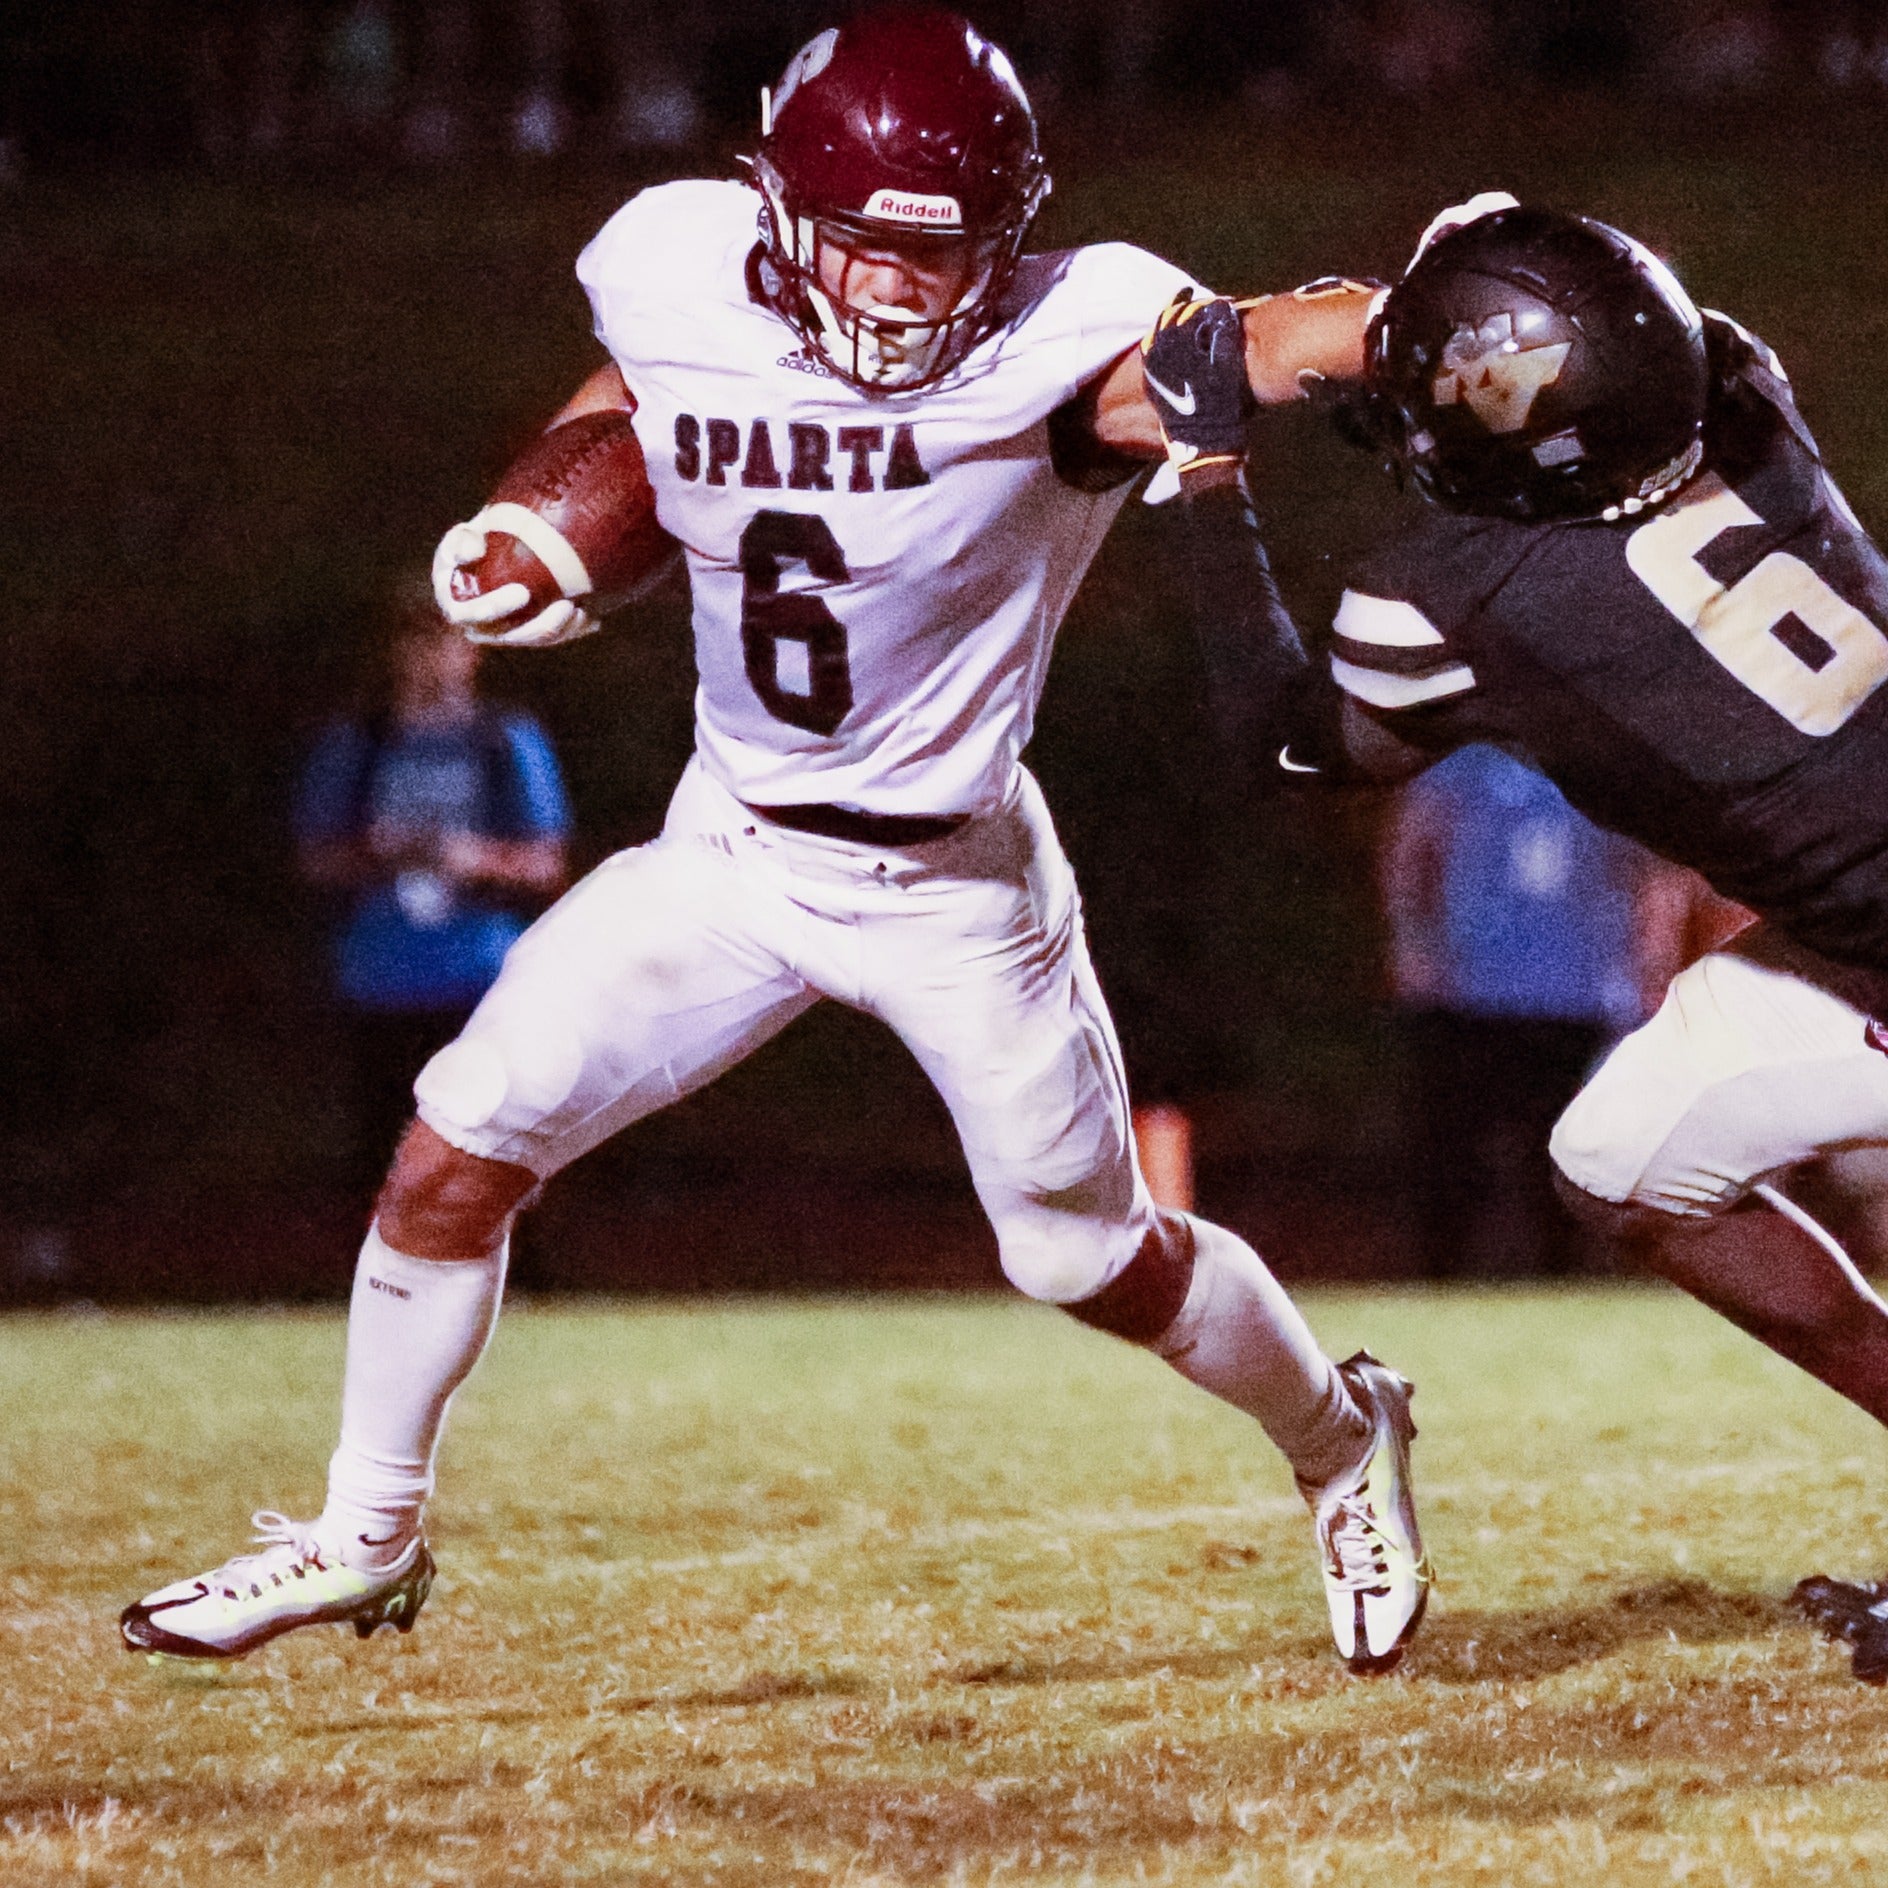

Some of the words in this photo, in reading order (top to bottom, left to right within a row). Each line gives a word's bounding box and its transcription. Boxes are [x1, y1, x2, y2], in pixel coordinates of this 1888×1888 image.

[880, 198, 952, 218] Riddell
[674, 413, 931, 493] SPARTA
[739, 509, 854, 737] 6
[1625, 470, 1888, 737] 6
